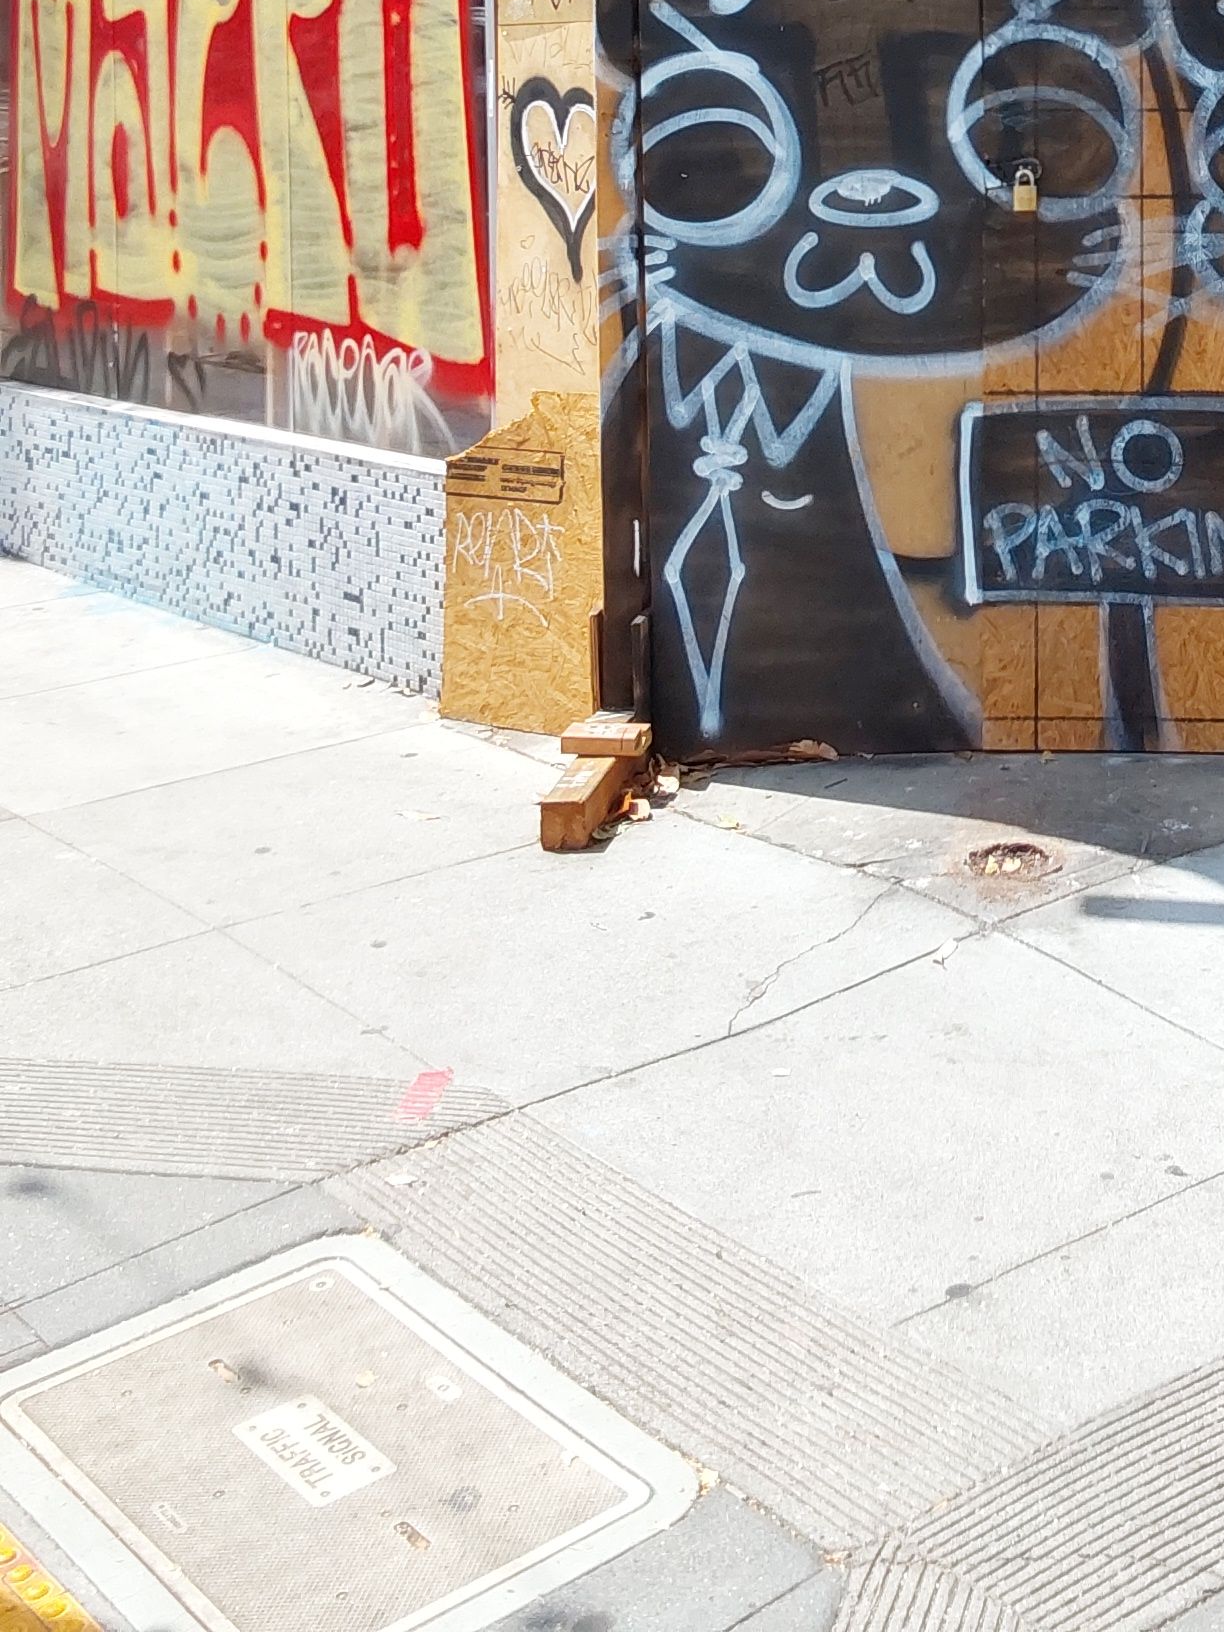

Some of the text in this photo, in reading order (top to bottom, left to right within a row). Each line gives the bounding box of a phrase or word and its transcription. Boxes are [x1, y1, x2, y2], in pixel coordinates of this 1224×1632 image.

[1035, 414, 1183, 493] NO
[259, 1427, 334, 1490] TRAFFIC
[303, 1413, 367, 1465] SIGNAL
